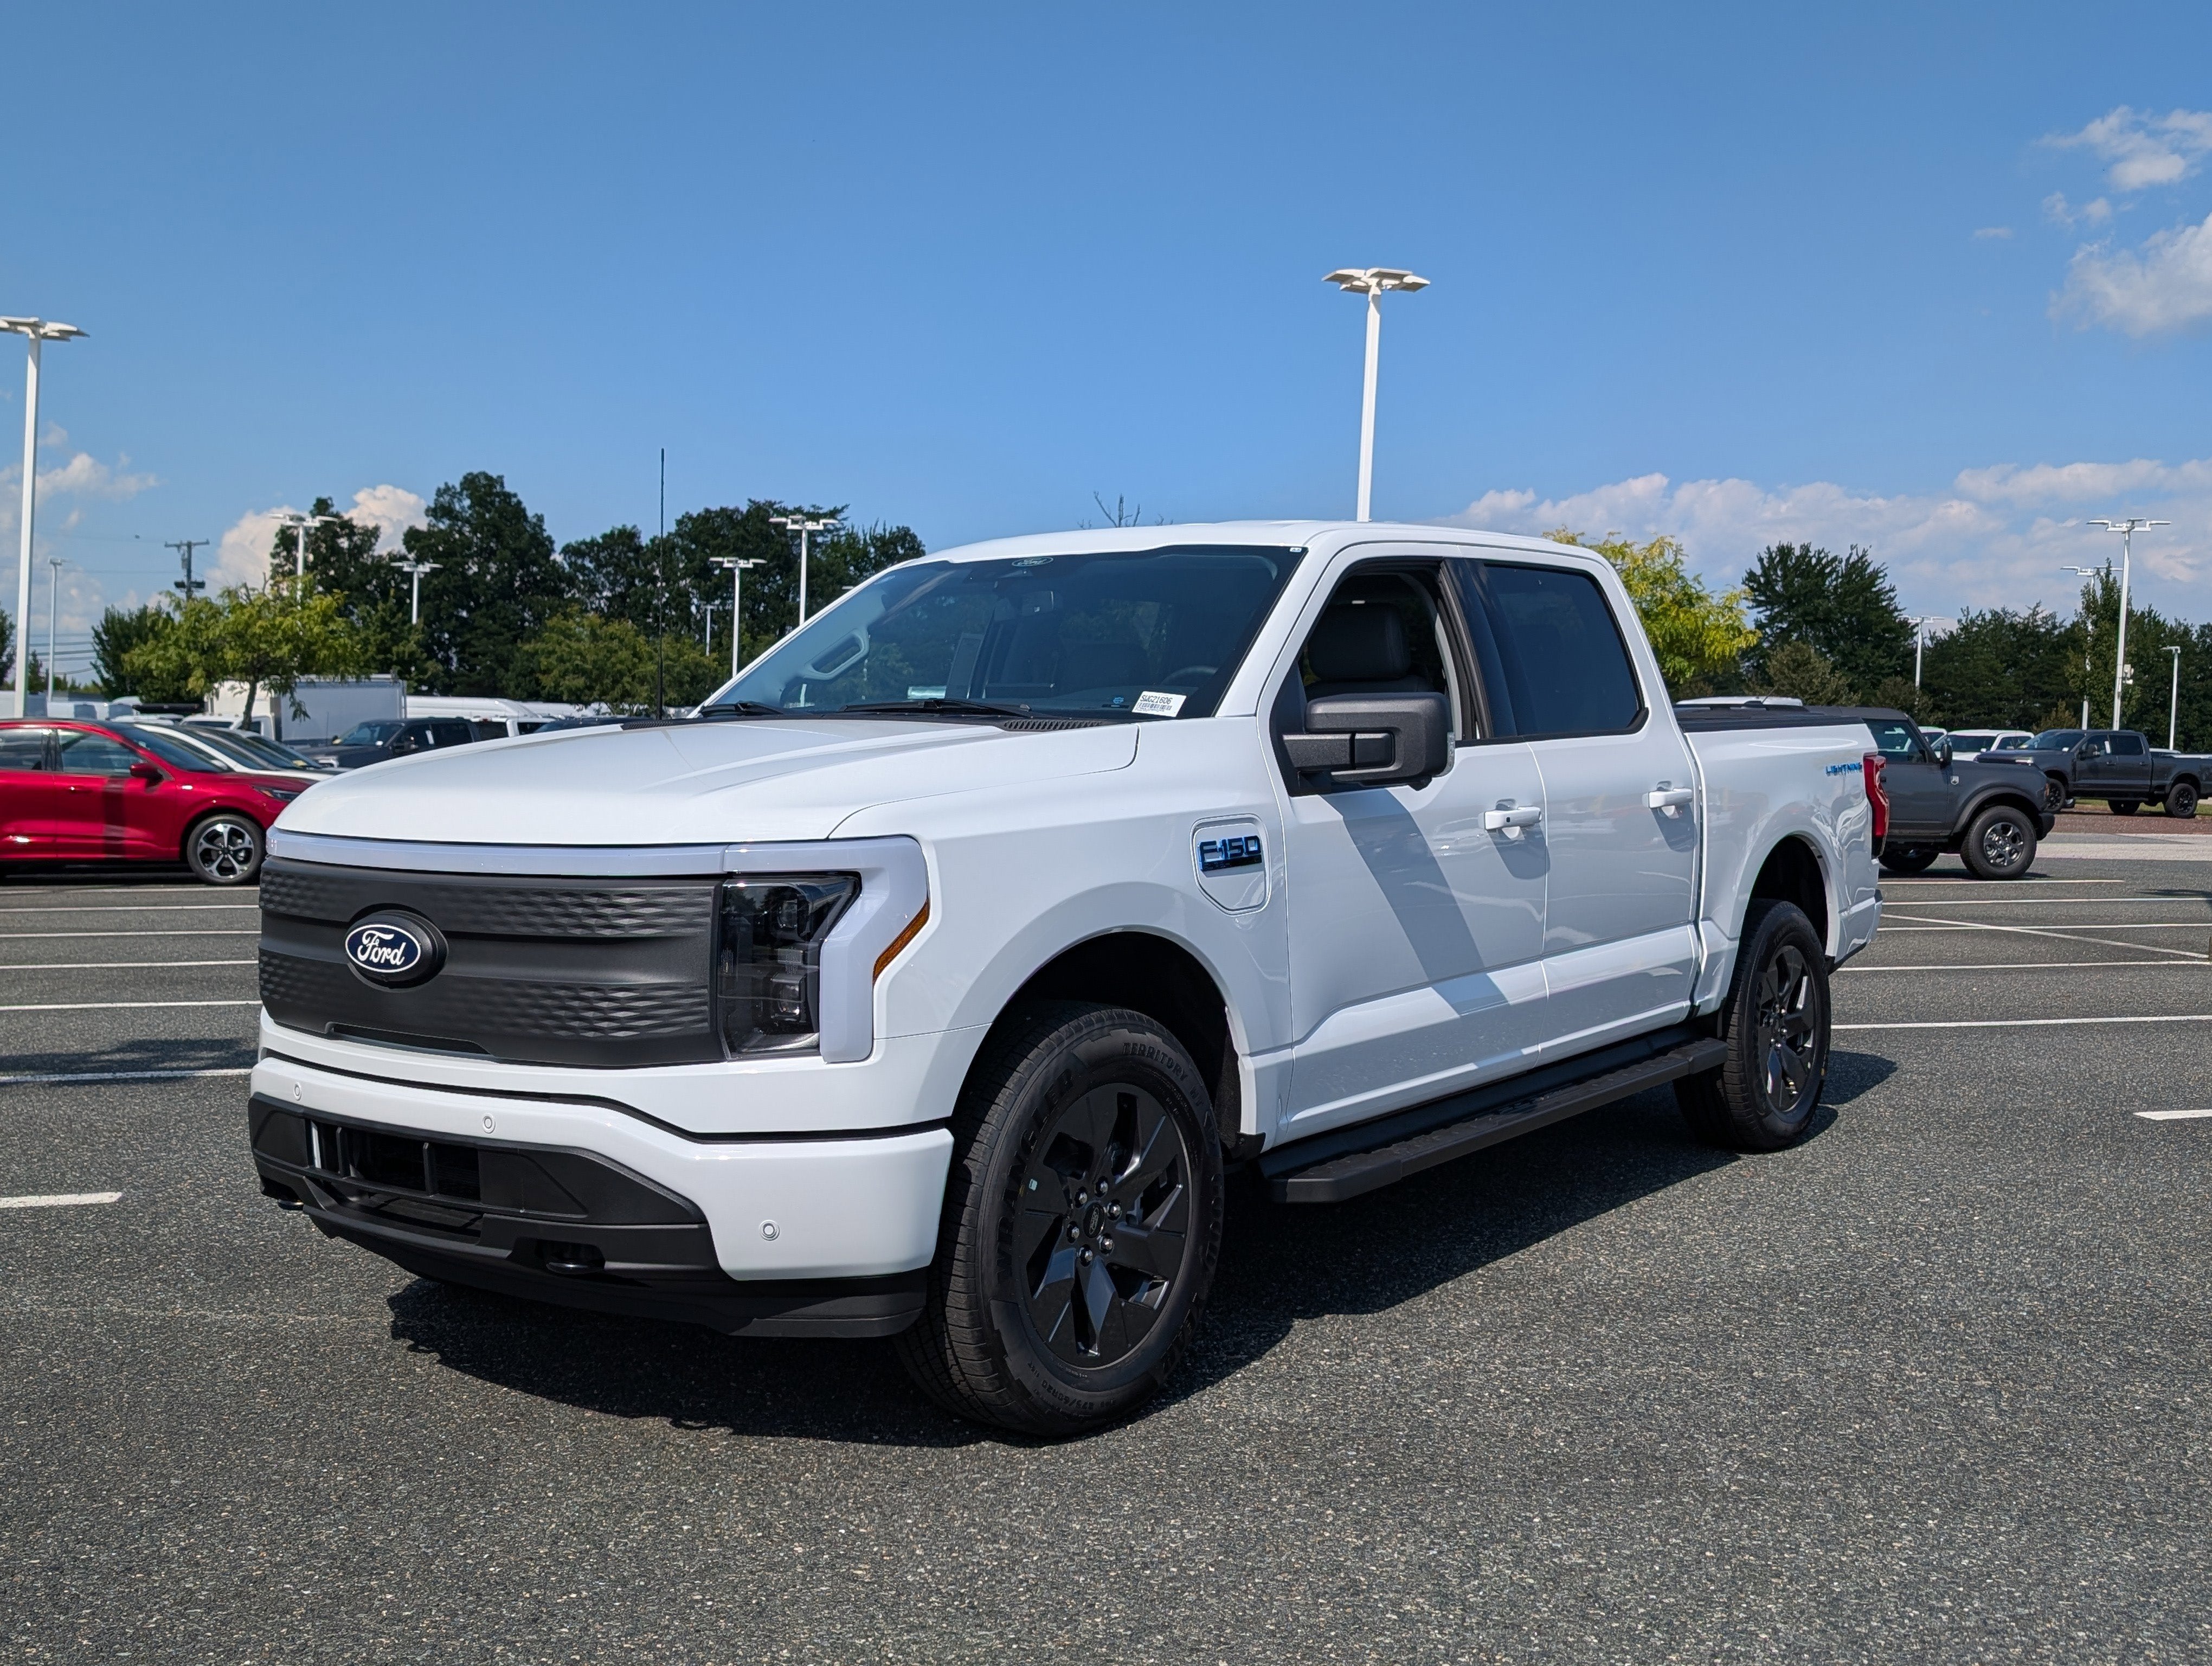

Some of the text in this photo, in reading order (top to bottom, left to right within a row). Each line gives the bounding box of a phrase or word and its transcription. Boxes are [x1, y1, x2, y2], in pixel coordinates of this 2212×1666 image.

[1197, 835, 1262, 869] F-150
[357, 930, 406, 965] Ford
[1122, 1042, 1188, 1081] TERRITORY
[996, 1068, 1073, 1285] WRANGLER
